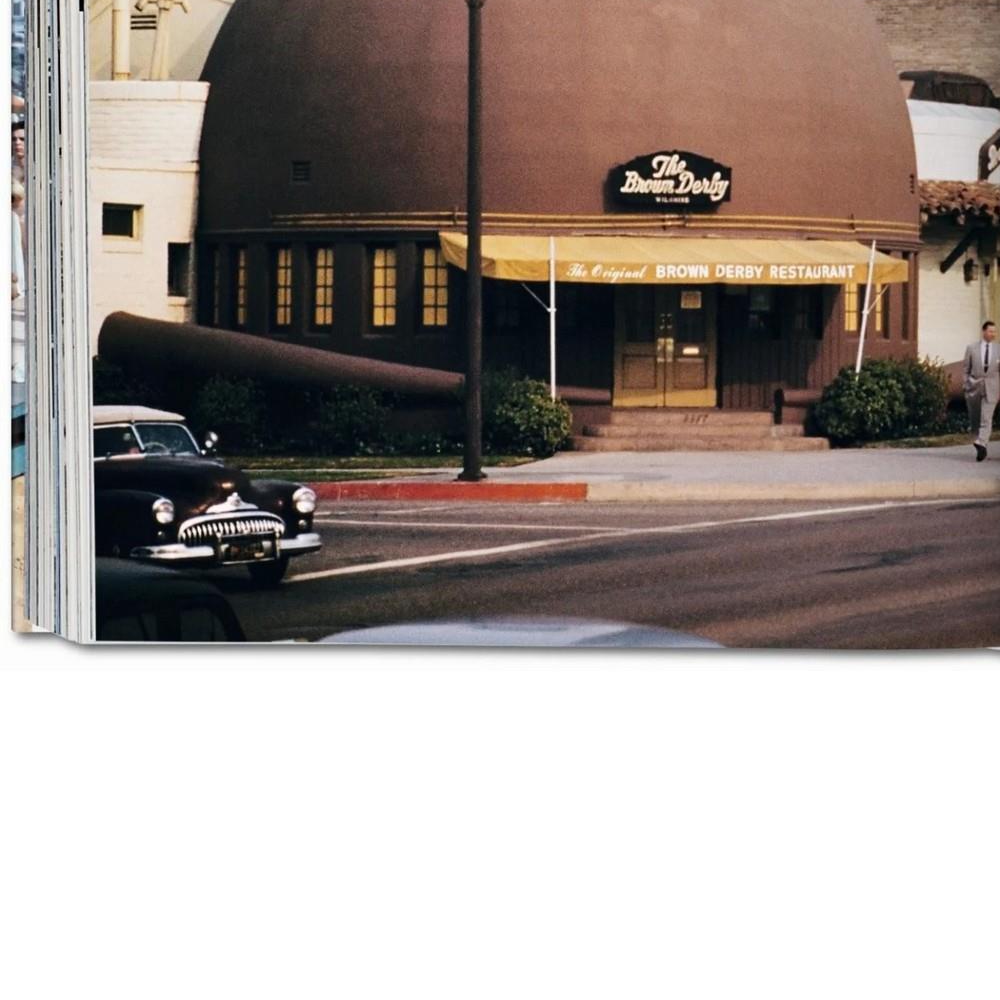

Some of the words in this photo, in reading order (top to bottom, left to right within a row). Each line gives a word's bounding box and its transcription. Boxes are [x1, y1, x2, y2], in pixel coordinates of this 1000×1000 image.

[651, 154, 687, 178] The
[620, 171, 675, 194] Brown
[674, 171, 730, 202] Derby
[565, 263, 588, 277] The
[591, 264, 648, 283] Original
[656, 264, 709, 279] BROWN
[715, 264, 763, 279] DERBY
[769, 264, 855, 279] RESTAURANT
